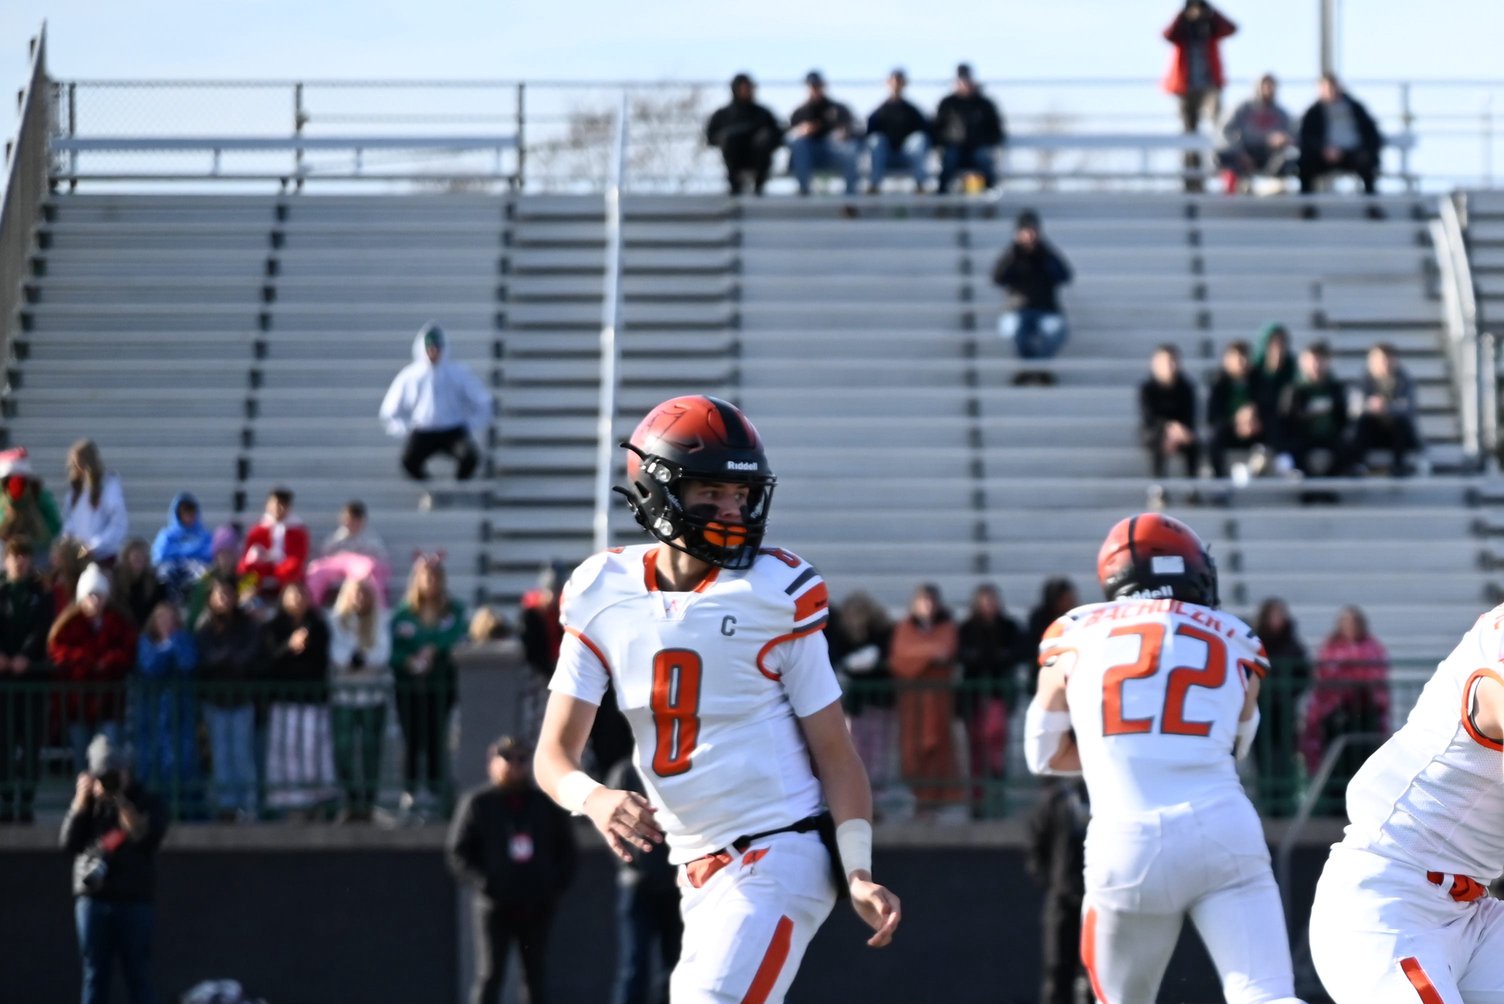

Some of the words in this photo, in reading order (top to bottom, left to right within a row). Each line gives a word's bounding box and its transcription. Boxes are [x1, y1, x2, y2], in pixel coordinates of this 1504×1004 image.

[727, 460, 759, 471] Riddell
[720, 615, 737, 637] C
[649, 648, 703, 777] 8
[1102, 622, 1228, 737] 22
